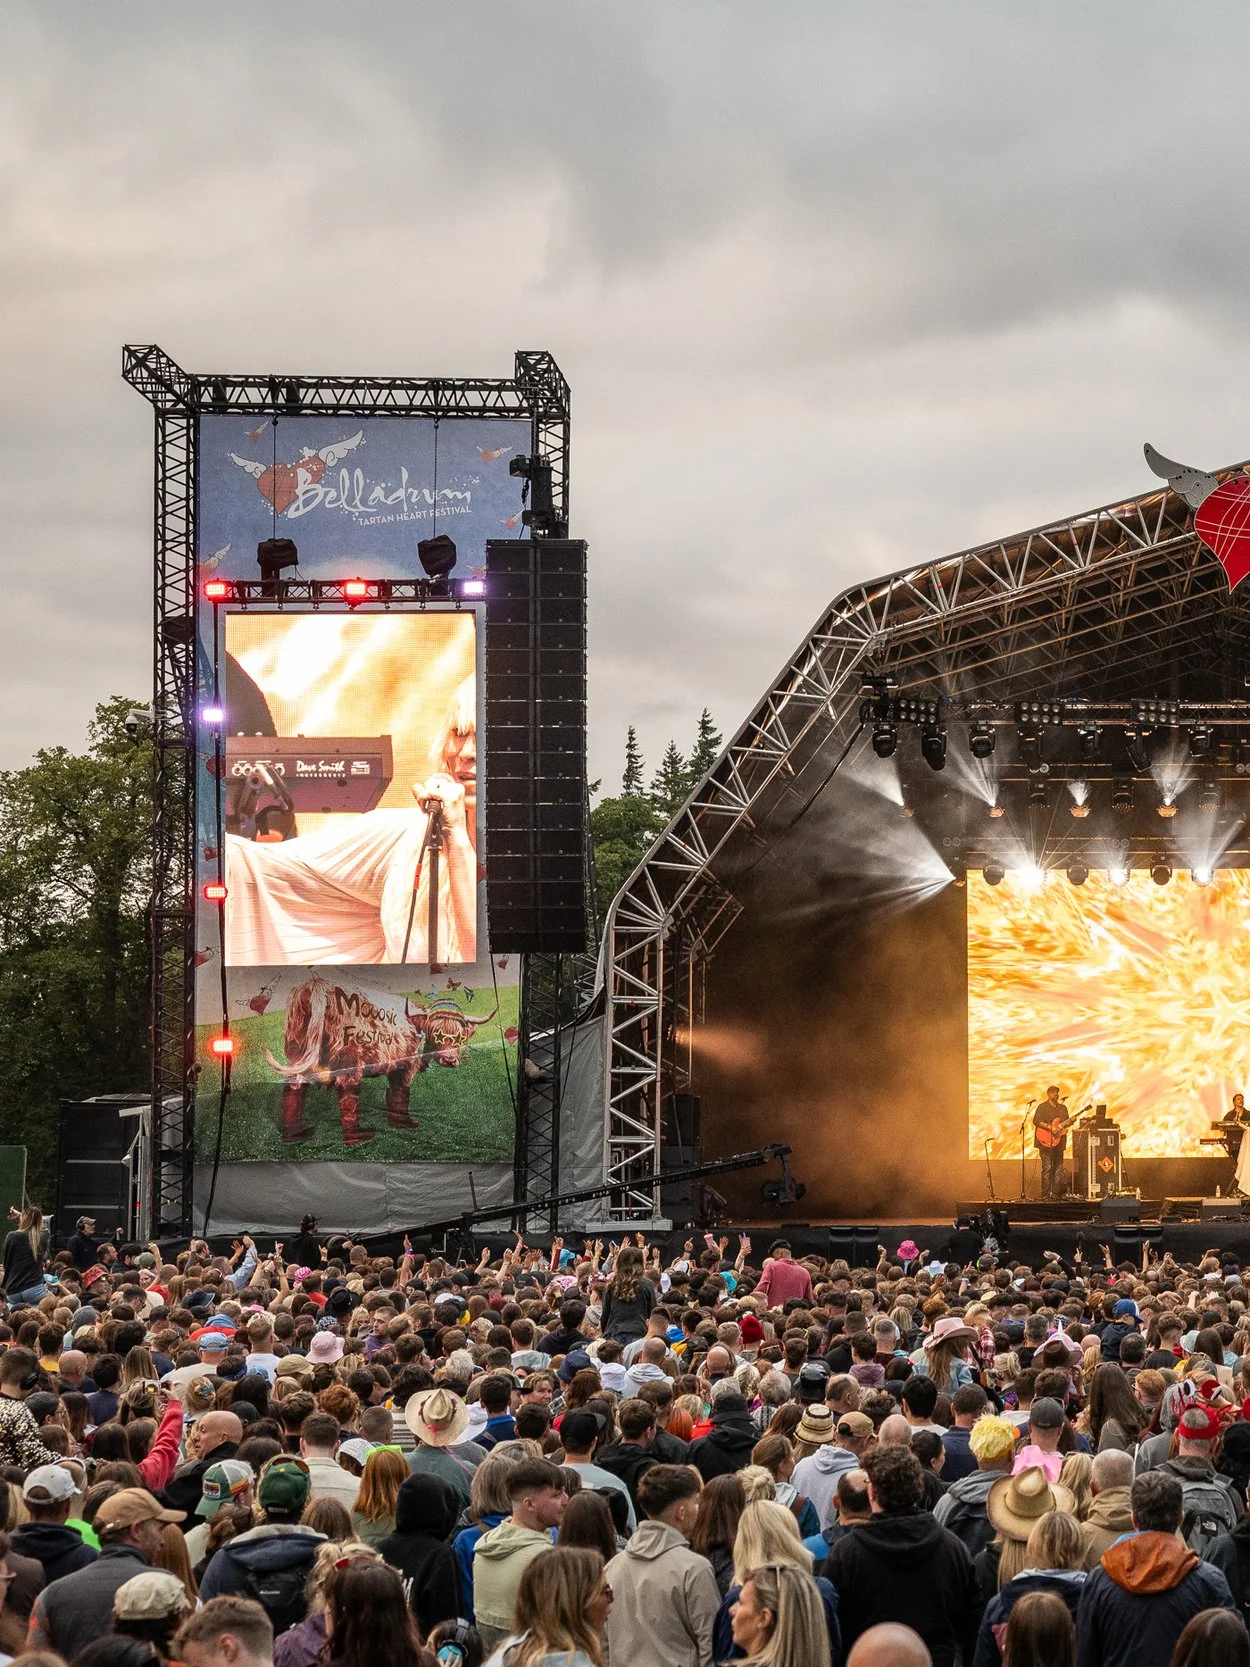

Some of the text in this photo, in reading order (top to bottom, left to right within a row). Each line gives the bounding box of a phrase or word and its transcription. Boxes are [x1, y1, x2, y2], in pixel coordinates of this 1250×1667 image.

[287, 466, 472, 519] Belladrum
[358, 505, 472, 526] TARTAN HEART FESTIVAL
[318, 760, 345, 772] Smith
